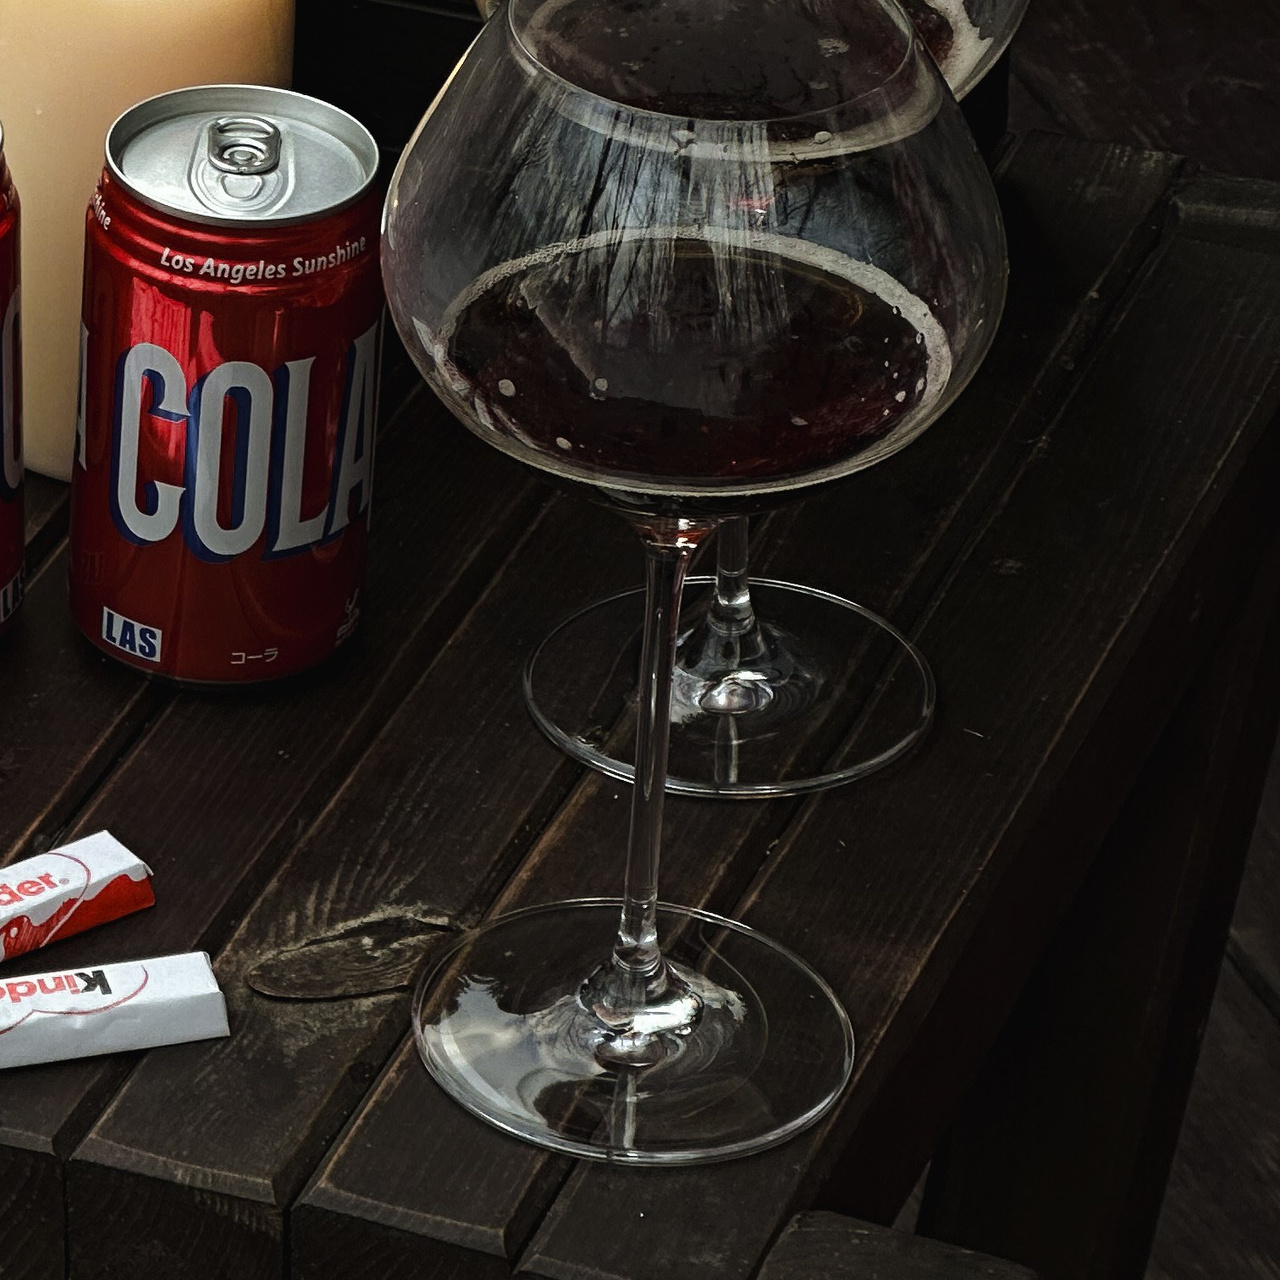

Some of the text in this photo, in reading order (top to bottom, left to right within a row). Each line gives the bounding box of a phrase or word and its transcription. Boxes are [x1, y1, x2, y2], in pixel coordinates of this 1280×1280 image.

[159, 236, 366, 284] Los Angeles Sunshine
[114, 320, 379, 564] COLA
[105, 610, 157, 659] LAS
[230, 647, 279, 665] コーラ
